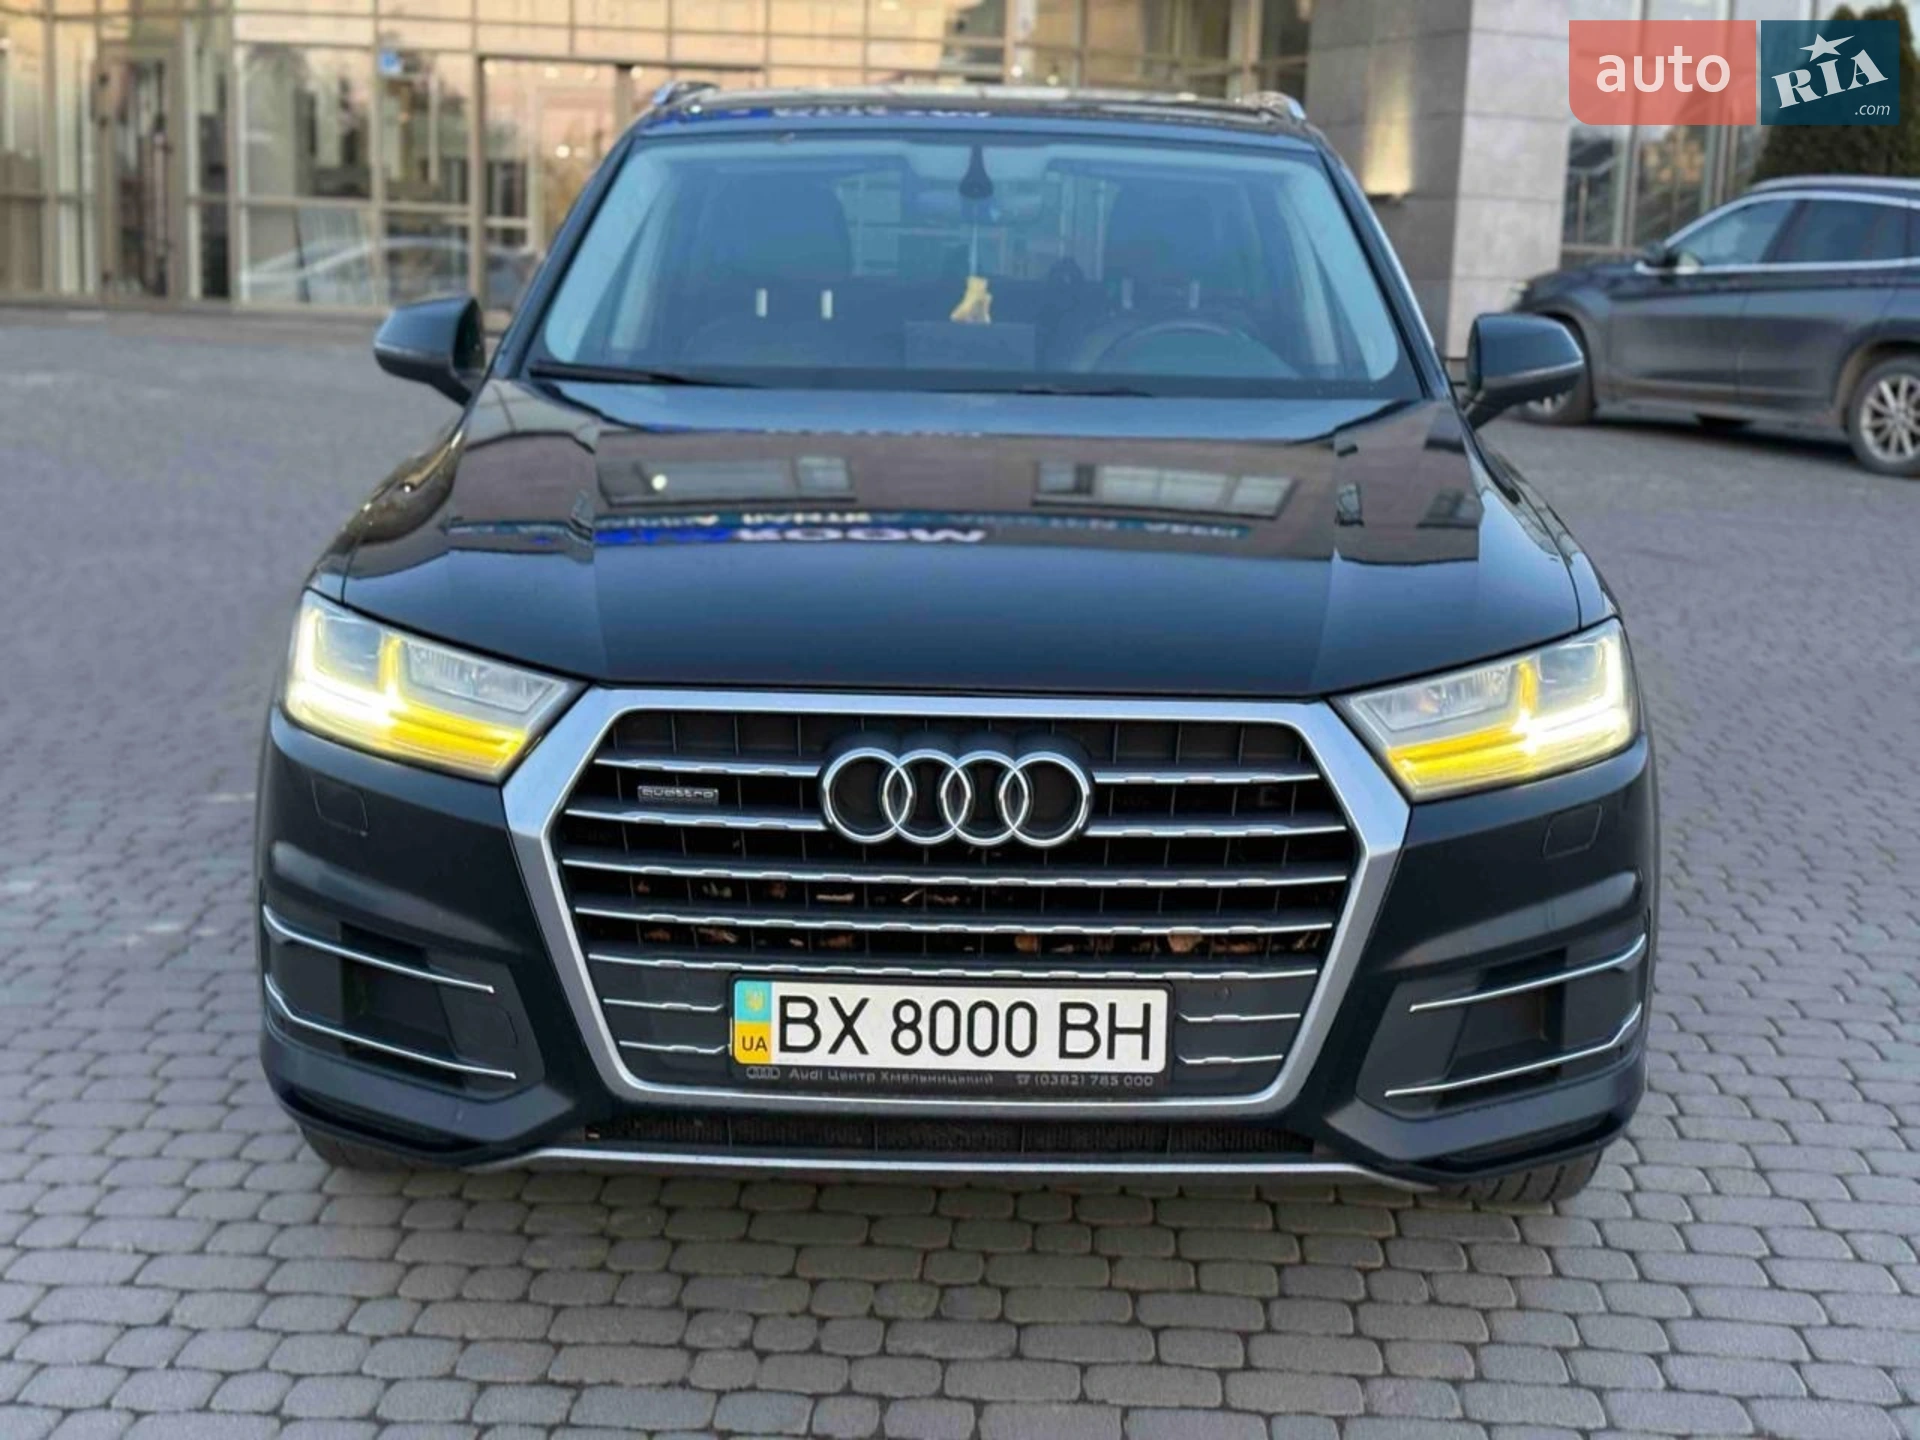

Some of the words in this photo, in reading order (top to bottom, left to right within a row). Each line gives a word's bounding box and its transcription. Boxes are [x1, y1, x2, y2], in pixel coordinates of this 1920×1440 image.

[641, 787, 715, 799] quattro
[778, 995, 869, 1056] BX
[891, 999, 1038, 1058] 8000
[1058, 1001, 1152, 1060] BH
[741, 1036, 768, 1052] UA
[789, 1067, 823, 1081] Audi
